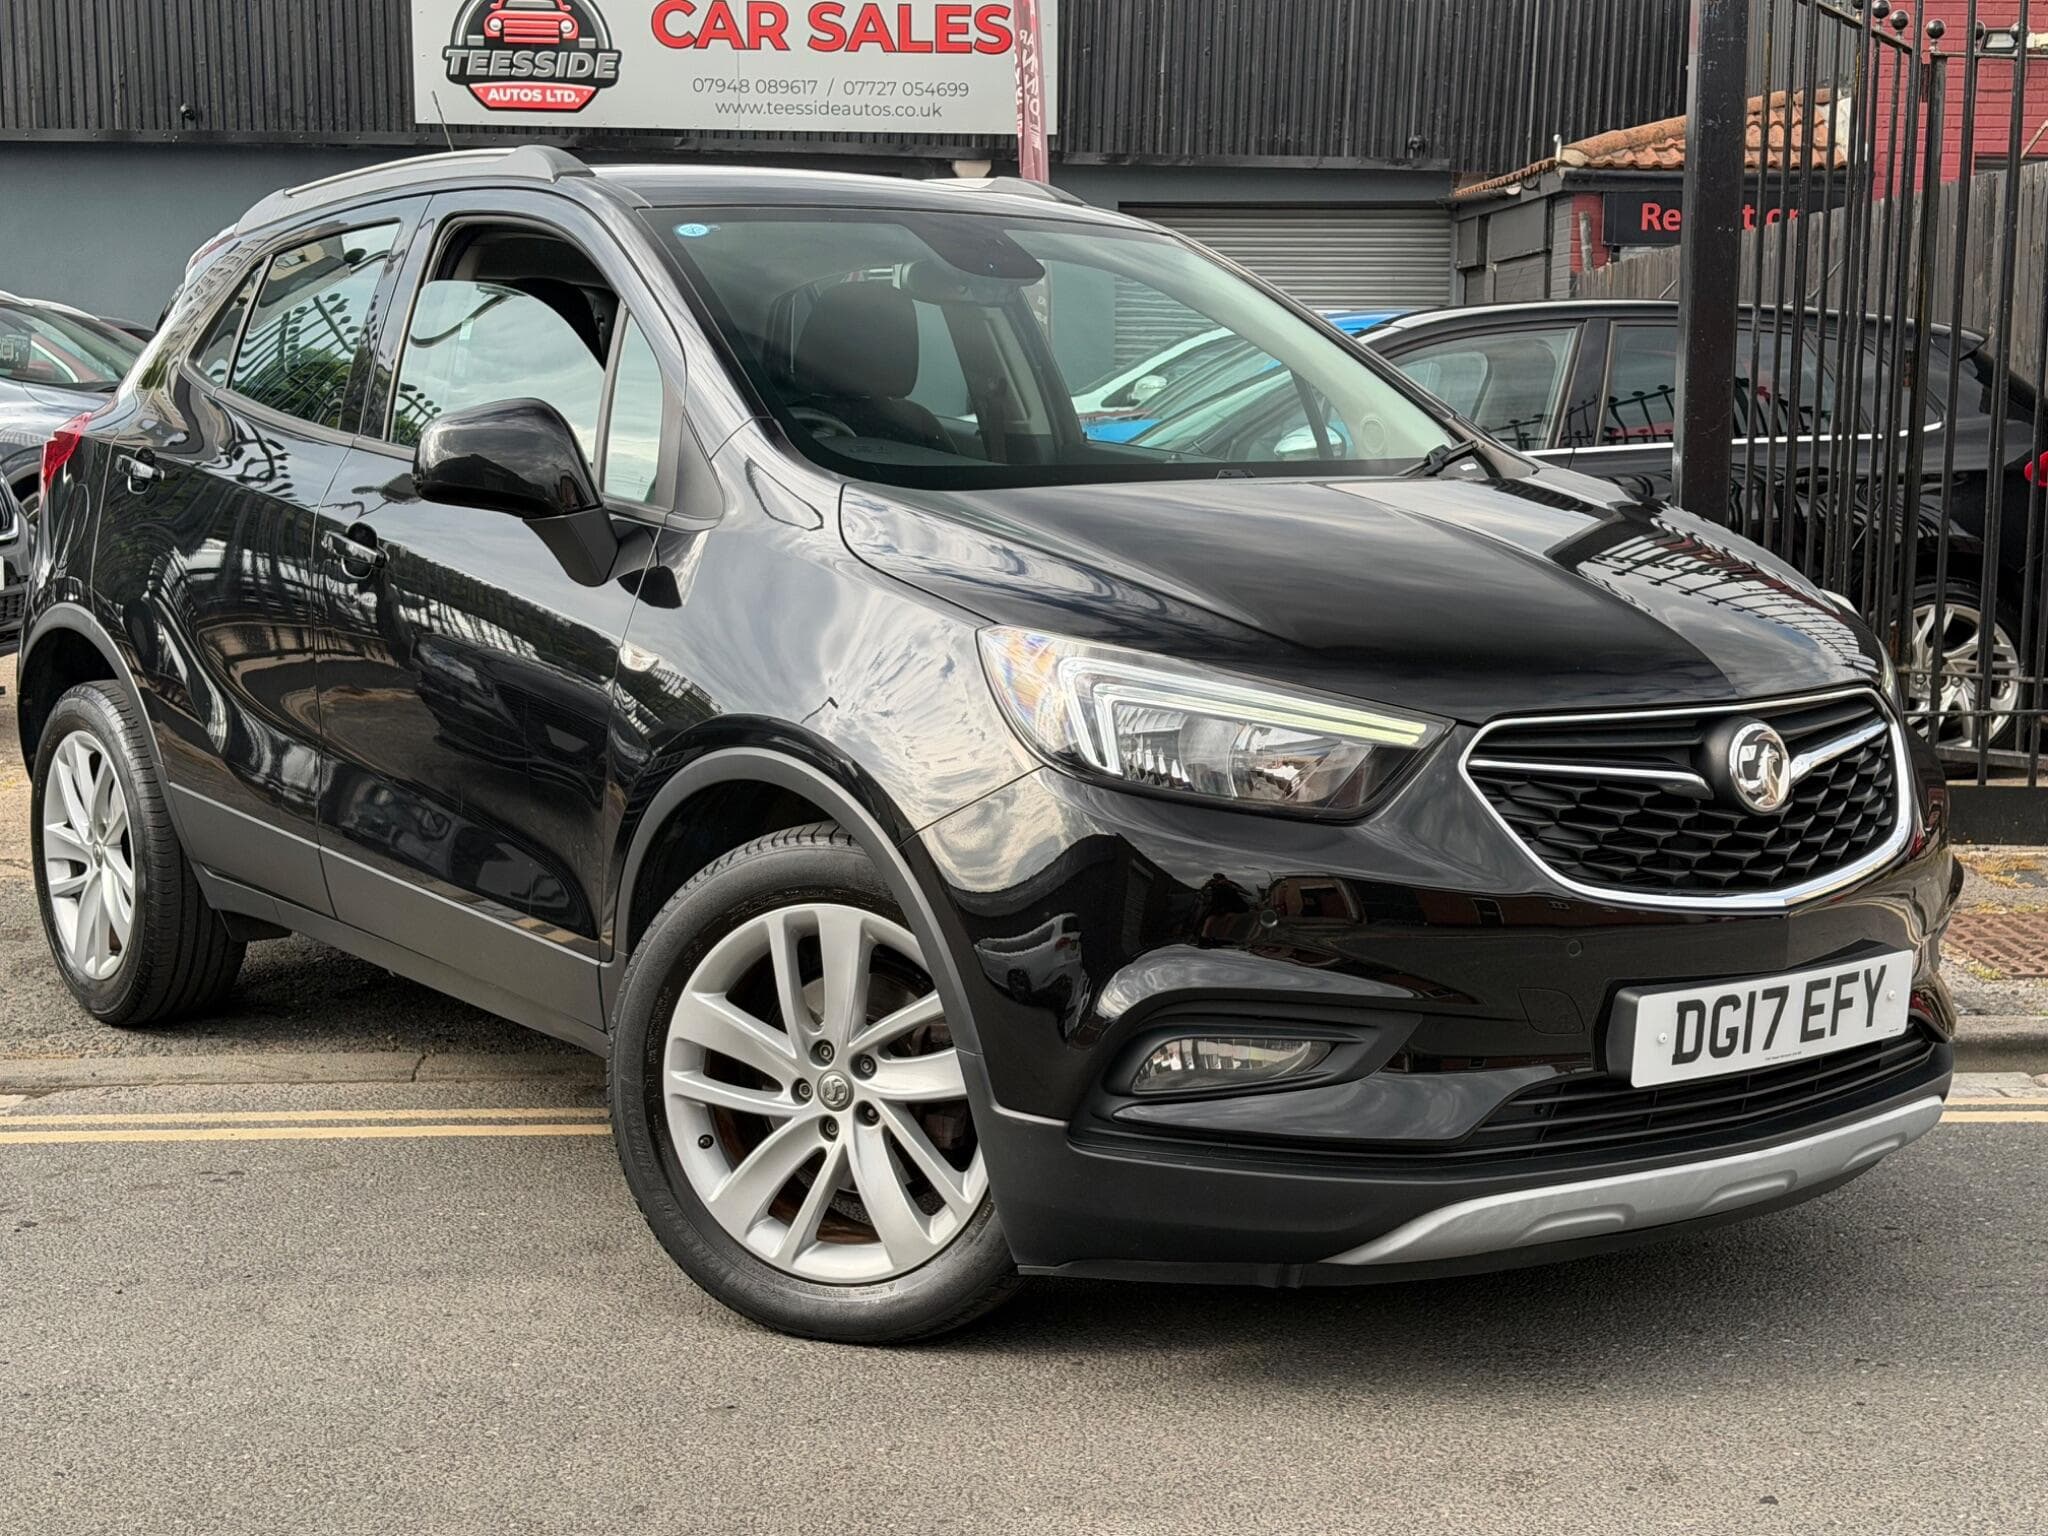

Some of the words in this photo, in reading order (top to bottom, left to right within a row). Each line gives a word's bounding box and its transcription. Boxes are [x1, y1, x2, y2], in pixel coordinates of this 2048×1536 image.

[651, 0, 790, 50] CAR
[807, 2, 1013, 54] SALES
[446, 49, 619, 79] TEESSIDE
[487, 88, 543, 102] AUTOS
[546, 89, 580, 103] LTD.
[692, 78, 750, 95] 07948
[755, 80, 818, 95] 089617
[843, 81, 897, 96] 07727
[902, 82, 969, 97] 054699
[715, 101, 943, 118] www.teessideautos.co.uk
[1671, 985, 1790, 1065] DG17
[1800, 964, 1887, 1042] EFY
